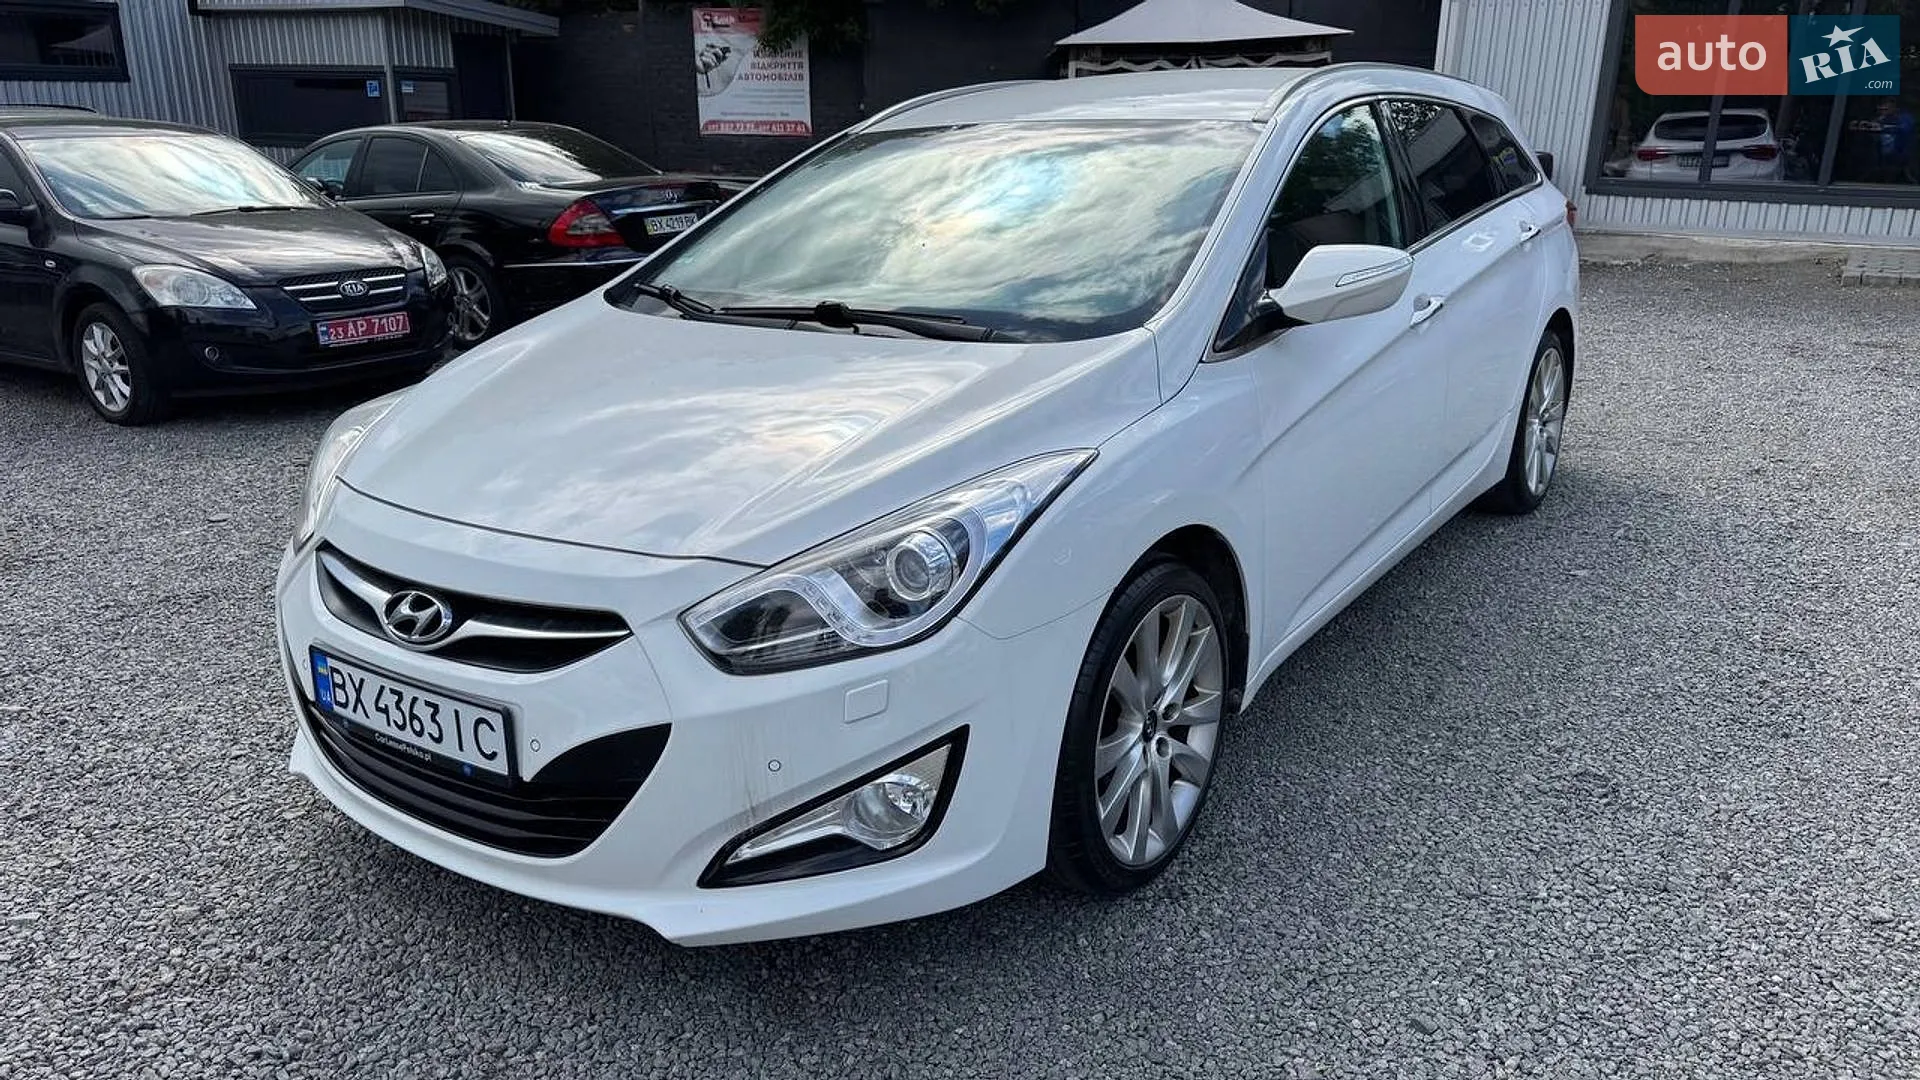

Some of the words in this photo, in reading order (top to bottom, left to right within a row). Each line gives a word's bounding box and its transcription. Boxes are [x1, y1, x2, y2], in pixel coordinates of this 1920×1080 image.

[738, 71, 804, 82] АВТОМОБІЛІВ
[651, 219, 664, 232] BX
[344, 284, 364, 293] KIA
[329, 327, 346, 340] 23
[347, 320, 368, 338] AP
[371, 315, 404, 335] 7107
[329, 665, 370, 719] BX
[374, 684, 444, 744] 4363
[453, 708, 498, 761] IC
